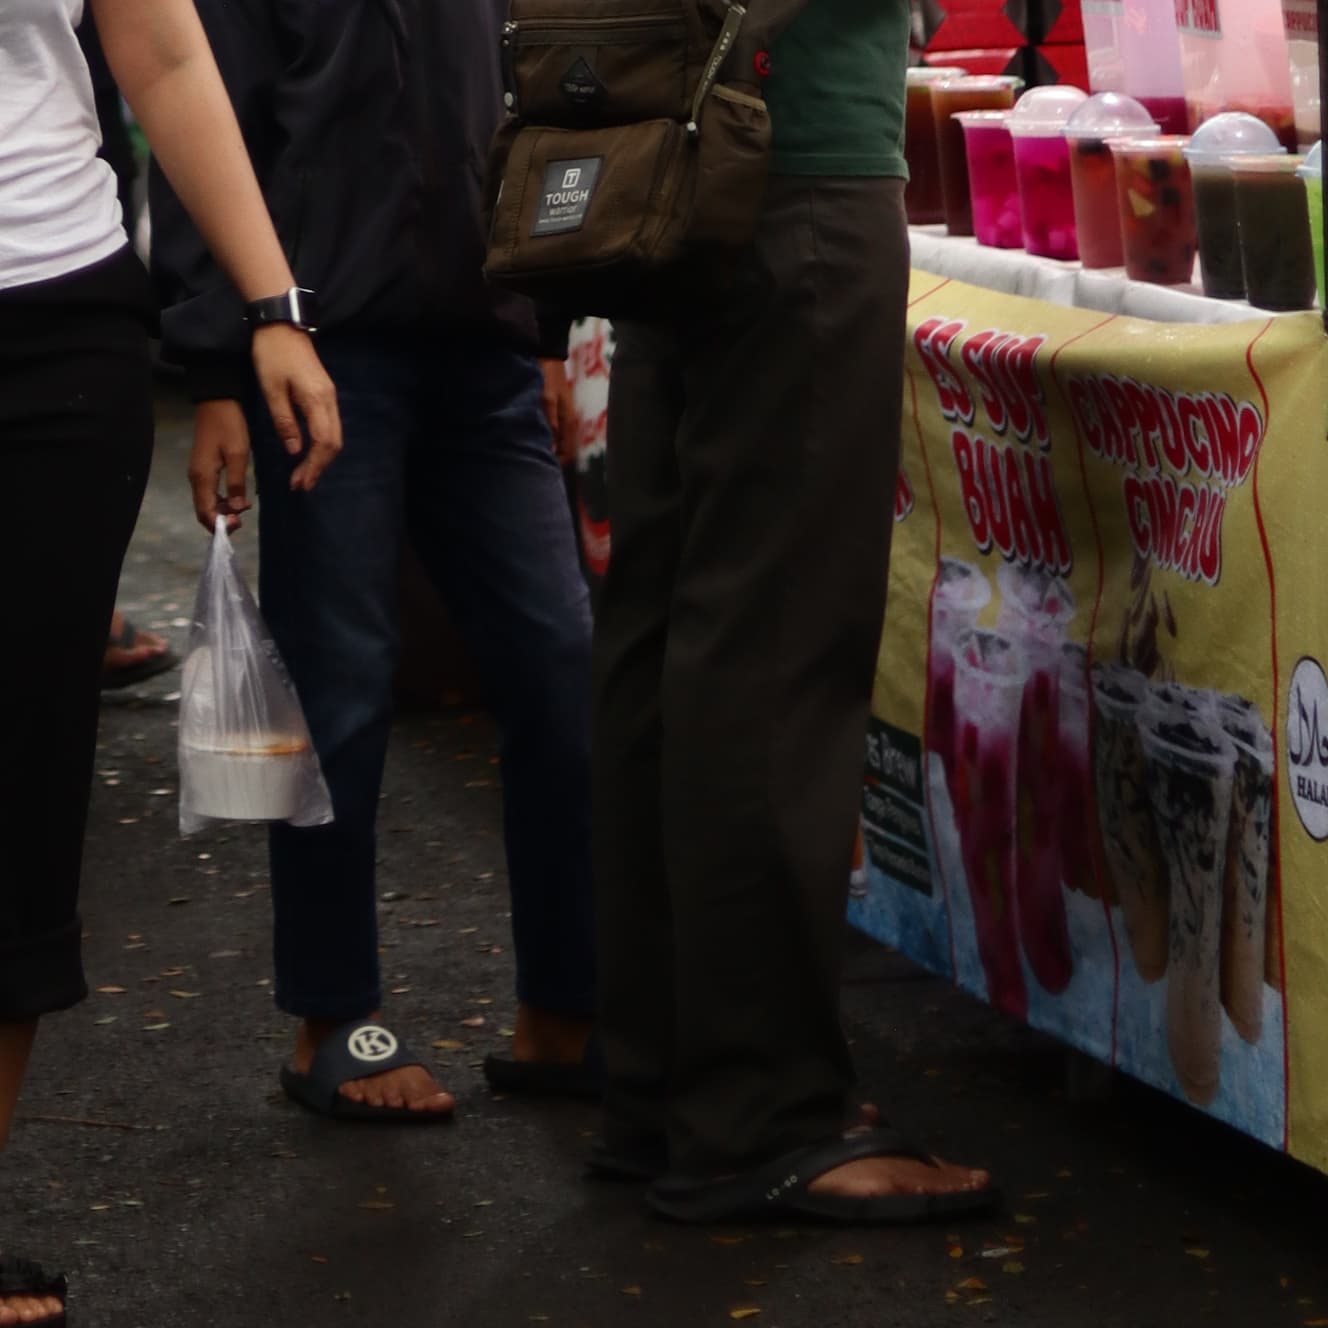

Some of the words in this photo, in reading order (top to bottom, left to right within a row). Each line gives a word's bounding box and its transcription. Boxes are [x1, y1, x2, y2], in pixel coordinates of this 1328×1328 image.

[545, 189, 589, 206] TOUGH
[914, 317, 974, 425] ES
[962, 329, 1050, 450] SUP
[1068, 373, 1262, 488] CAPPUCINO
[953, 428, 1071, 576] BUAH
[1124, 474, 1226, 587] CINCAU
[1297, 775, 1328, 807] HALA
